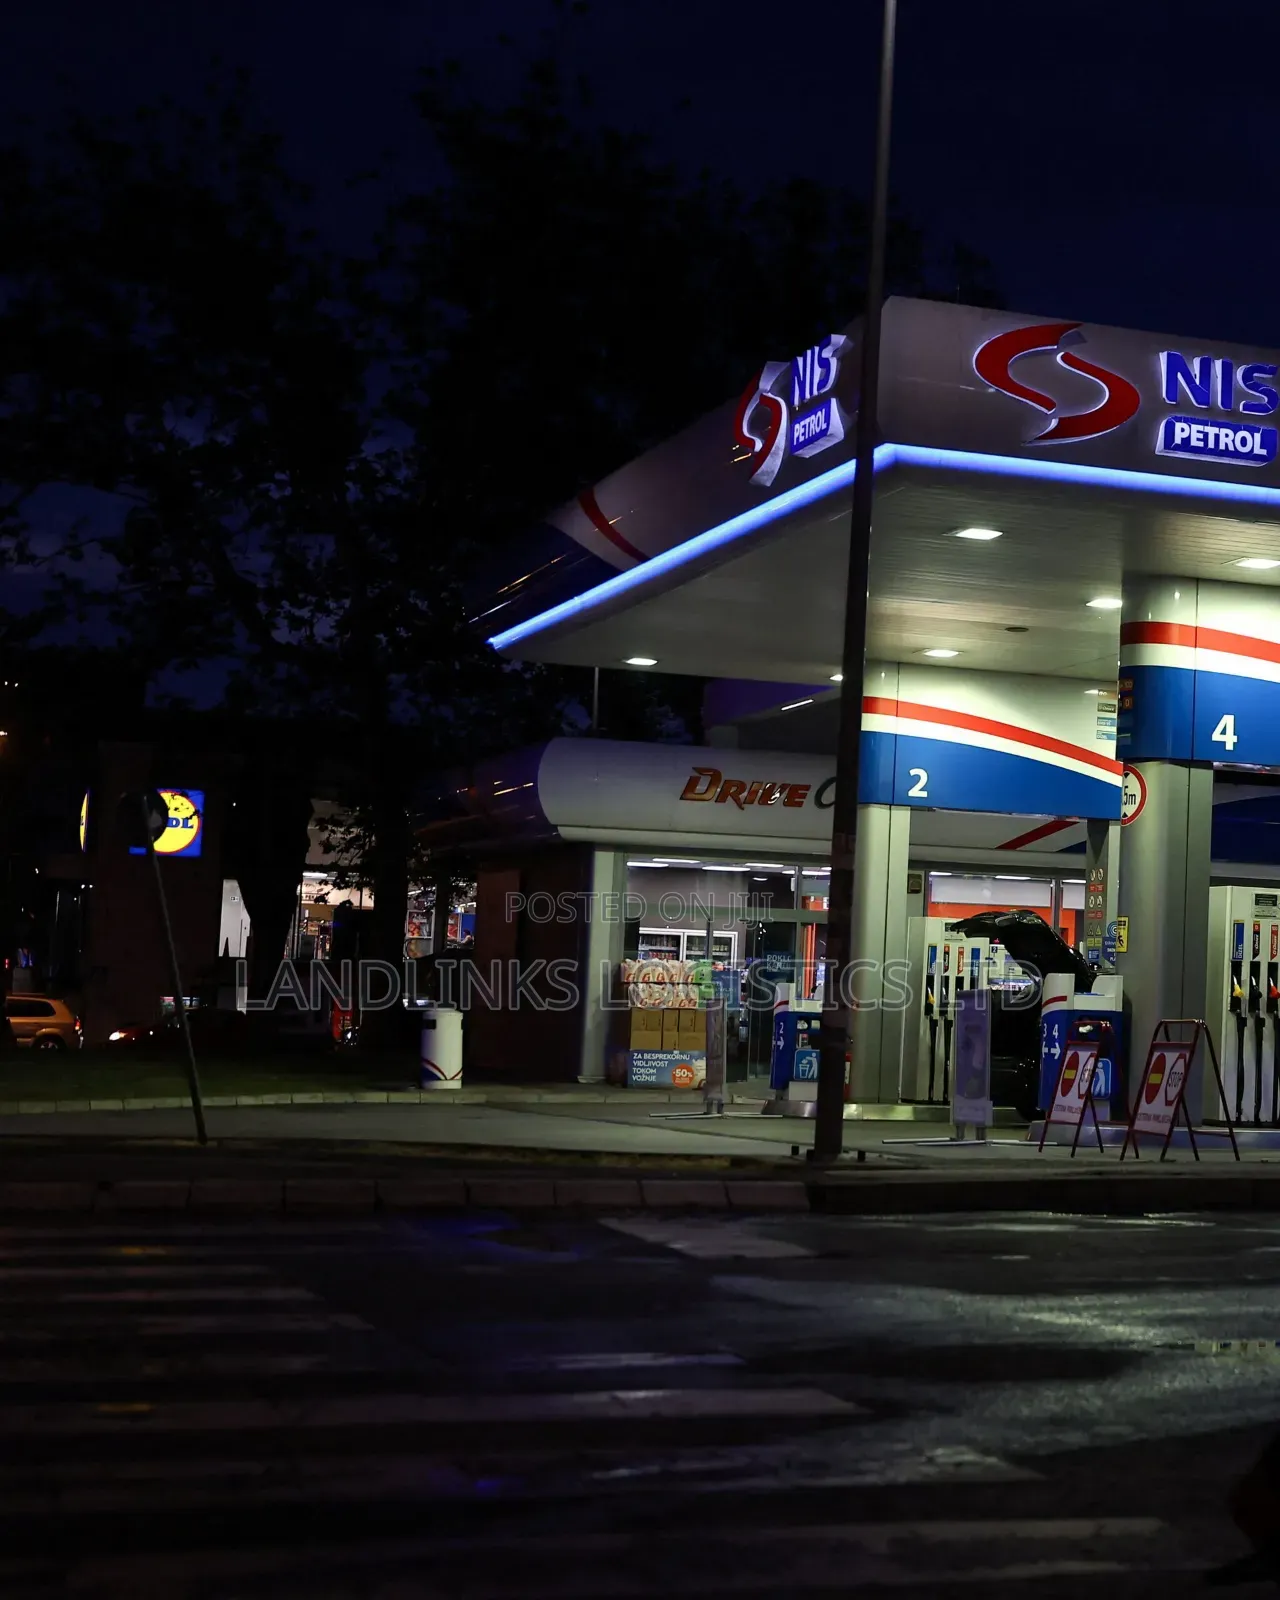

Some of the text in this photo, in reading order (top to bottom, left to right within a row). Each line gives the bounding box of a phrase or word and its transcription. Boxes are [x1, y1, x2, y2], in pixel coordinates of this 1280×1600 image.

[791, 334, 846, 407] NIS
[1159, 351, 1279, 416] NIS
[793, 408, 827, 446] PETROL
[1174, 421, 1268, 455] PETROL
[1212, 715, 1238, 751] 4
[908, 768, 929, 798] 2
[779, 1022, 785, 1034] 2
[1052, 1024, 1059, 1039] 4
